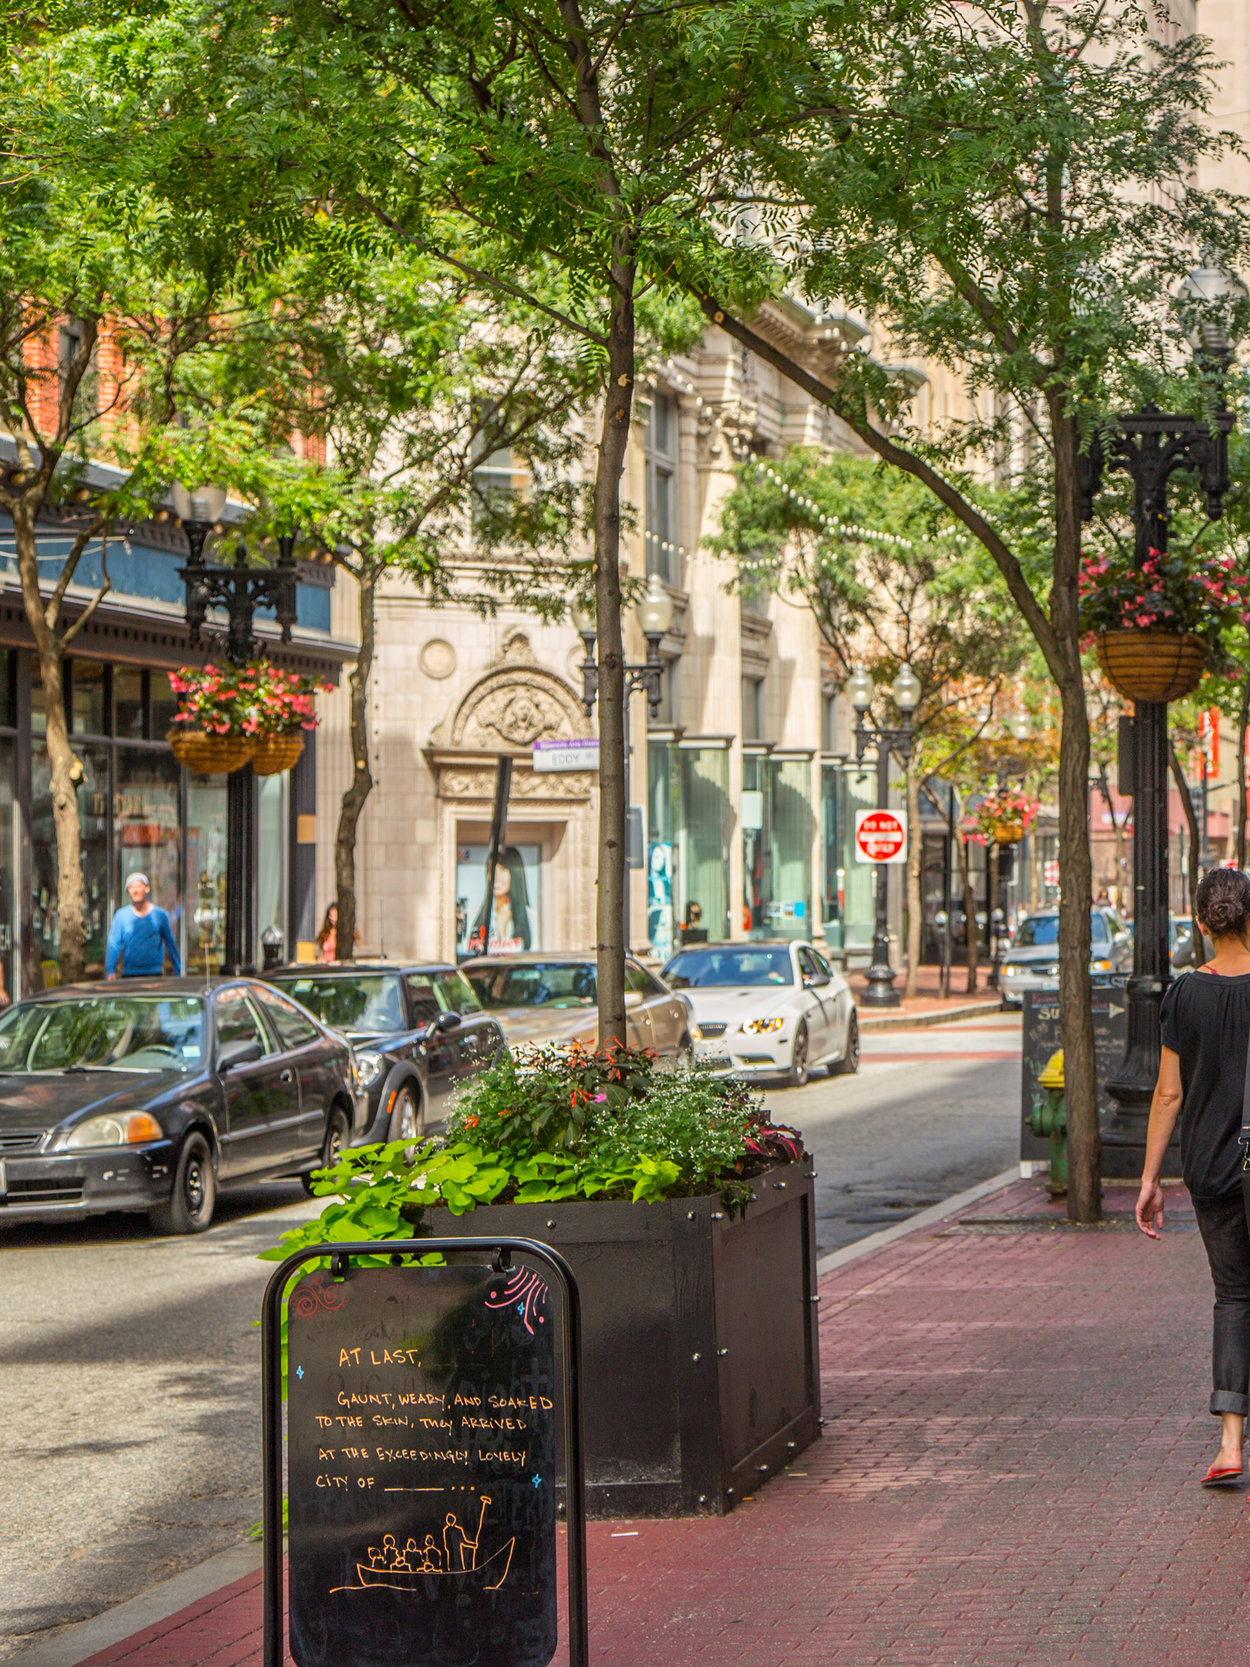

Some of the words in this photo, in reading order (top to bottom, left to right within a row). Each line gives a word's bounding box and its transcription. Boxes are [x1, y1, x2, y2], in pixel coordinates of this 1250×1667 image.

[552, 753, 579, 766] EDDY
[864, 821, 877, 830] DO
[879, 821, 898, 830] NOT
[338, 1347, 361, 1368] AT
[371, 1349, 422, 1368] LAST,
[337, 1392, 395, 1409] GAUNT,
[398, 1393, 451, 1411] WEARY,
[454, 1395, 482, 1407] AND
[487, 1395, 553, 1410] SOAKED
[316, 1415, 332, 1429] TO
[336, 1416, 363, 1428] THE
[372, 1415, 414, 1429] SKIN,
[319, 1449, 335, 1460] AT
[342, 1448, 368, 1458] THE
[377, 1448, 468, 1465] EXCEEDINGLY
[479, 1449, 526, 1467] LOVELY
[357, 1477, 375, 1488] OF
